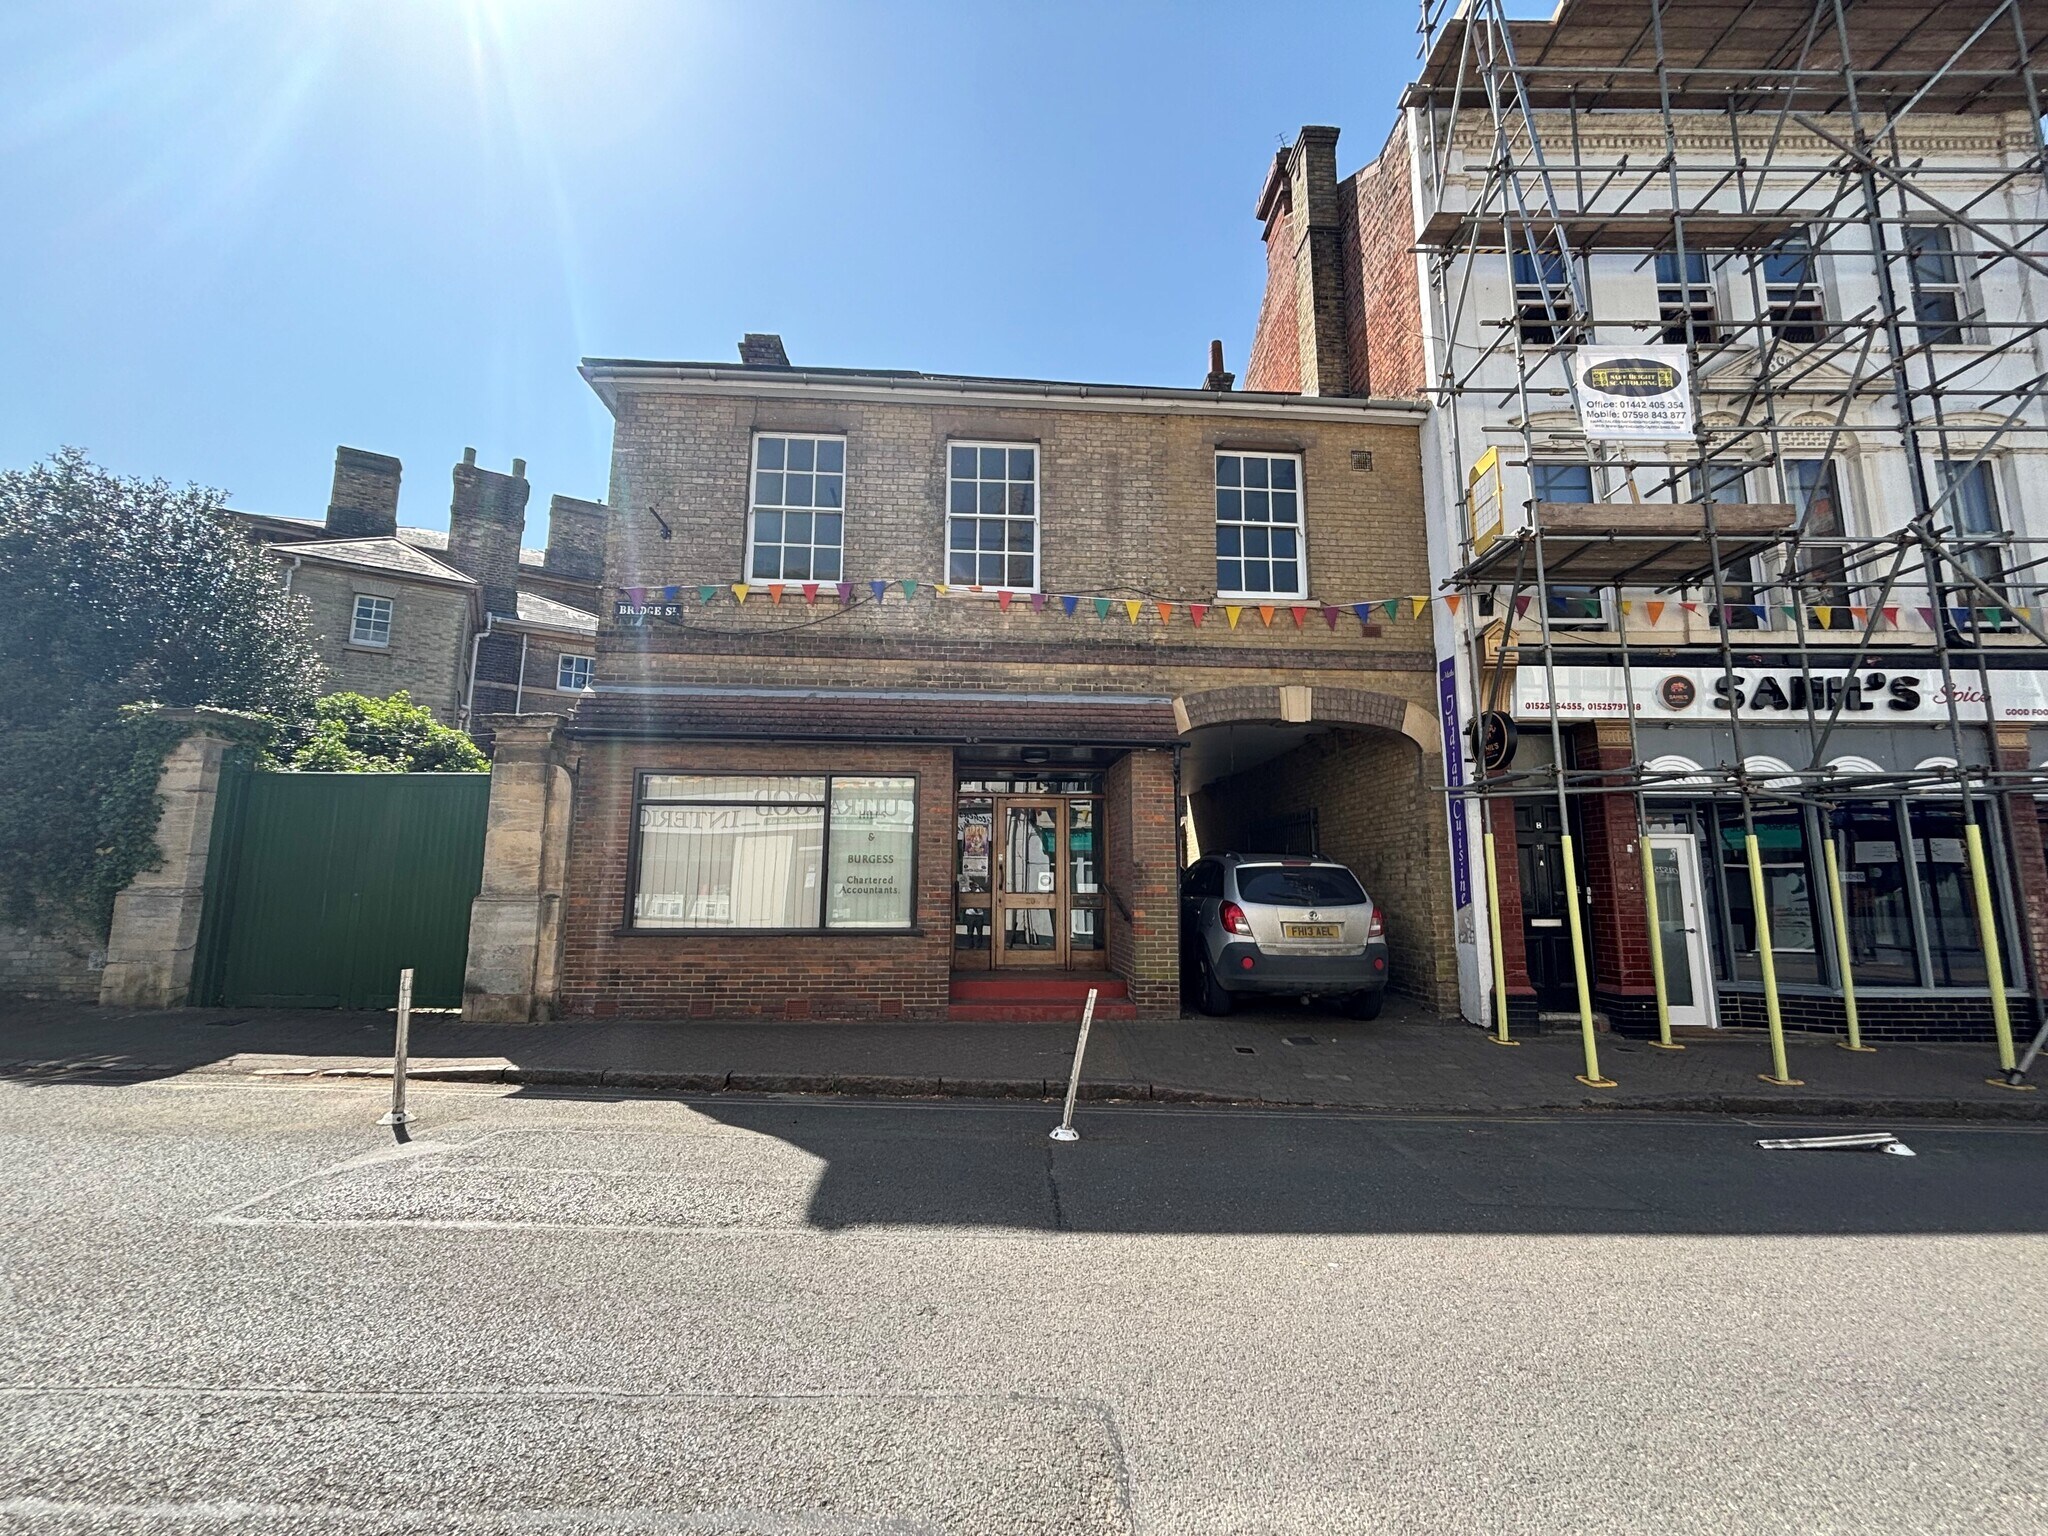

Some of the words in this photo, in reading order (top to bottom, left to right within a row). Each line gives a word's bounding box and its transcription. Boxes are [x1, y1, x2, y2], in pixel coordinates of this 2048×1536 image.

[1586, 401, 1617, 409] Office:
[1620, 401, 1646, 409] 01442
[1649, 401, 1665, 409] 405
[1668, 402, 1684, 410] 354
[1586, 411, 1619, 419] Mobile:
[1622, 411, 1649, 419] 07598
[1652, 412, 1668, 420] 843
[1670, 412, 1686, 420] 877
[619, 605, 662, 615] BRDGE
[1525, 702, 1584, 711] 0152554555,
[1587, 703, 1641, 711] 0152579118
[2005, 708, 2029, 716] GOOD
[867, 833, 875, 841] &
[1453, 799, 1469, 905] Cuisine
[848, 855, 894, 863] BURGESS
[847, 876, 893, 884] Chartered
[1292, 927, 1314, 936] FH13
[1316, 927, 1333, 936] AEL
